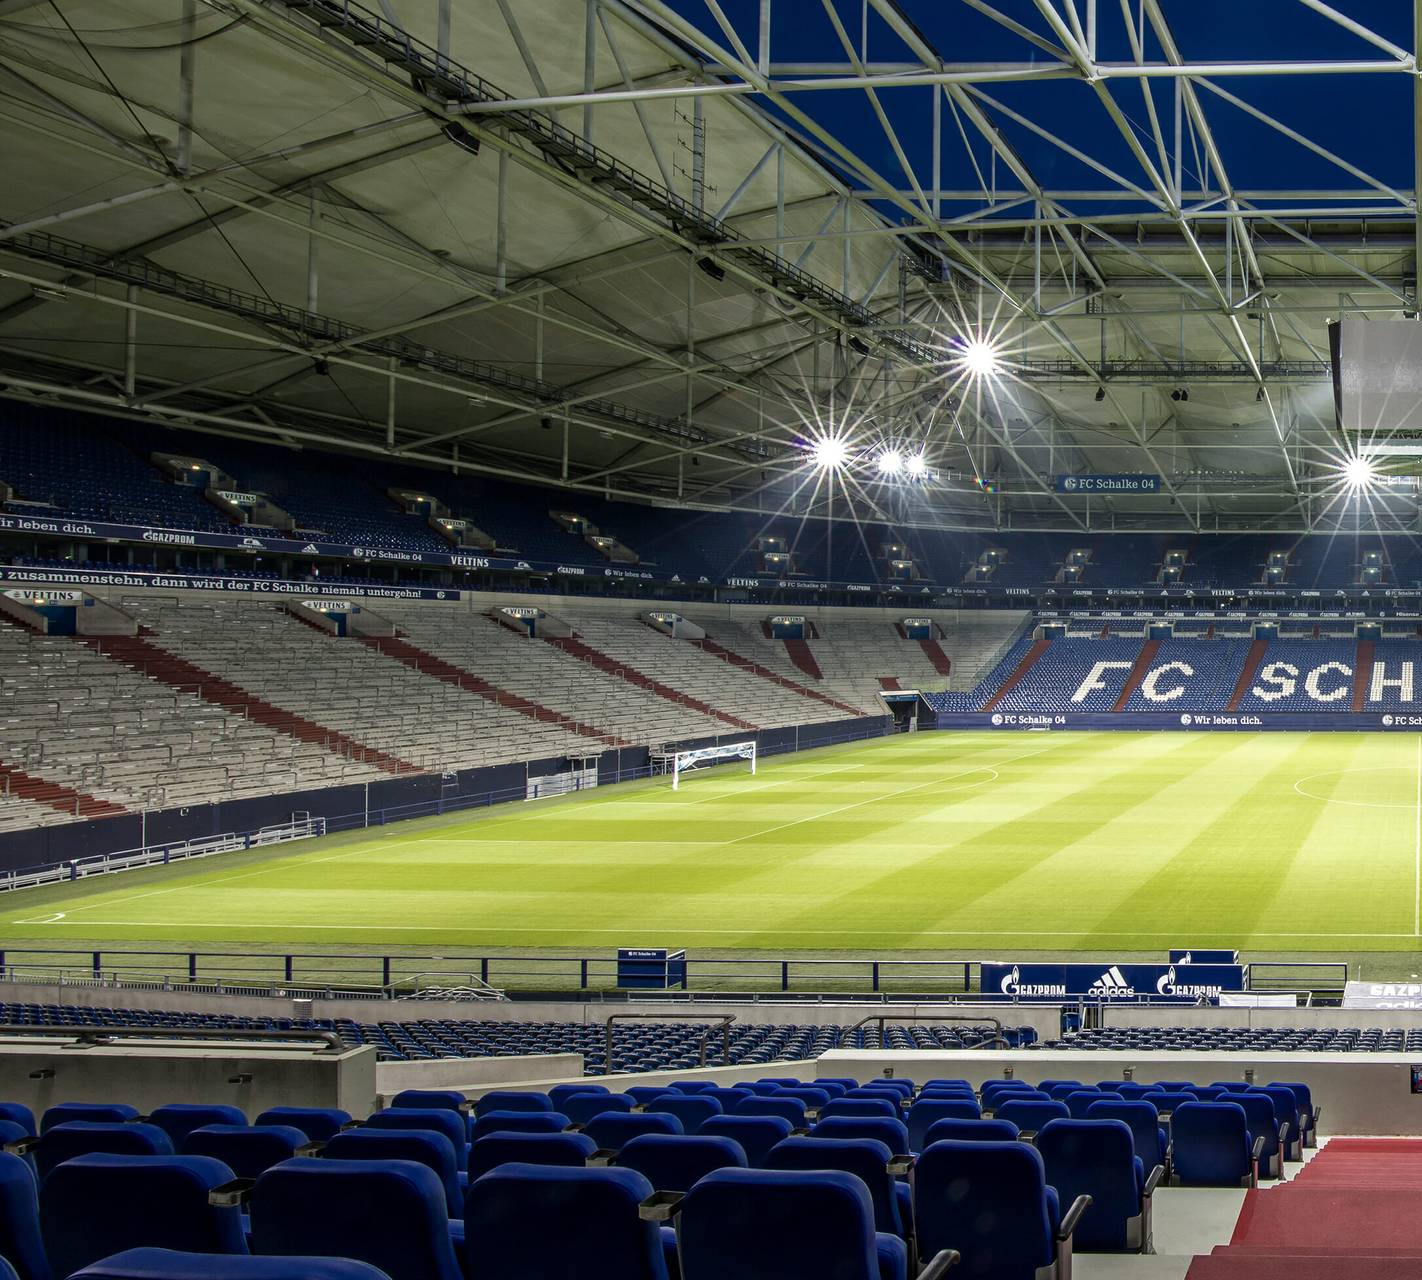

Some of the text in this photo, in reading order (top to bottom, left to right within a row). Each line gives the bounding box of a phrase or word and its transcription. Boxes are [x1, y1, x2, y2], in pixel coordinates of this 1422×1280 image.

[1079, 479, 1154, 489] FC Schalke 04
[0, 516, 96, 535] ir leben dich.
[152, 532, 195, 545] GAZPROM
[365, 550, 422, 562] FC Schalke 04
[451, 556, 489, 568] VELTINS
[8, 570, 148, 587] zusammenstehn,
[152, 575, 188, 588] dann
[192, 577, 224, 590] wird
[227, 580, 251, 591] der
[253, 582, 270, 592] FC
[272, 583, 319, 594] Schalke
[321, 585, 365, 597] niemals
[367, 587, 422, 600] untergehn!
[727, 577, 759, 588] VELTINS
[1070, 661, 1195, 704] FC
[1004, 715, 1066, 724] FC Schalke 04
[1194, 716, 1262, 725] Wir leben dich.
[1395, 717, 1408, 725] FC
[1019, 984, 1066, 996] GAZPROM
[1088, 983, 1135, 997] adidas
[1176, 985, 1222, 998] GAZPROM
